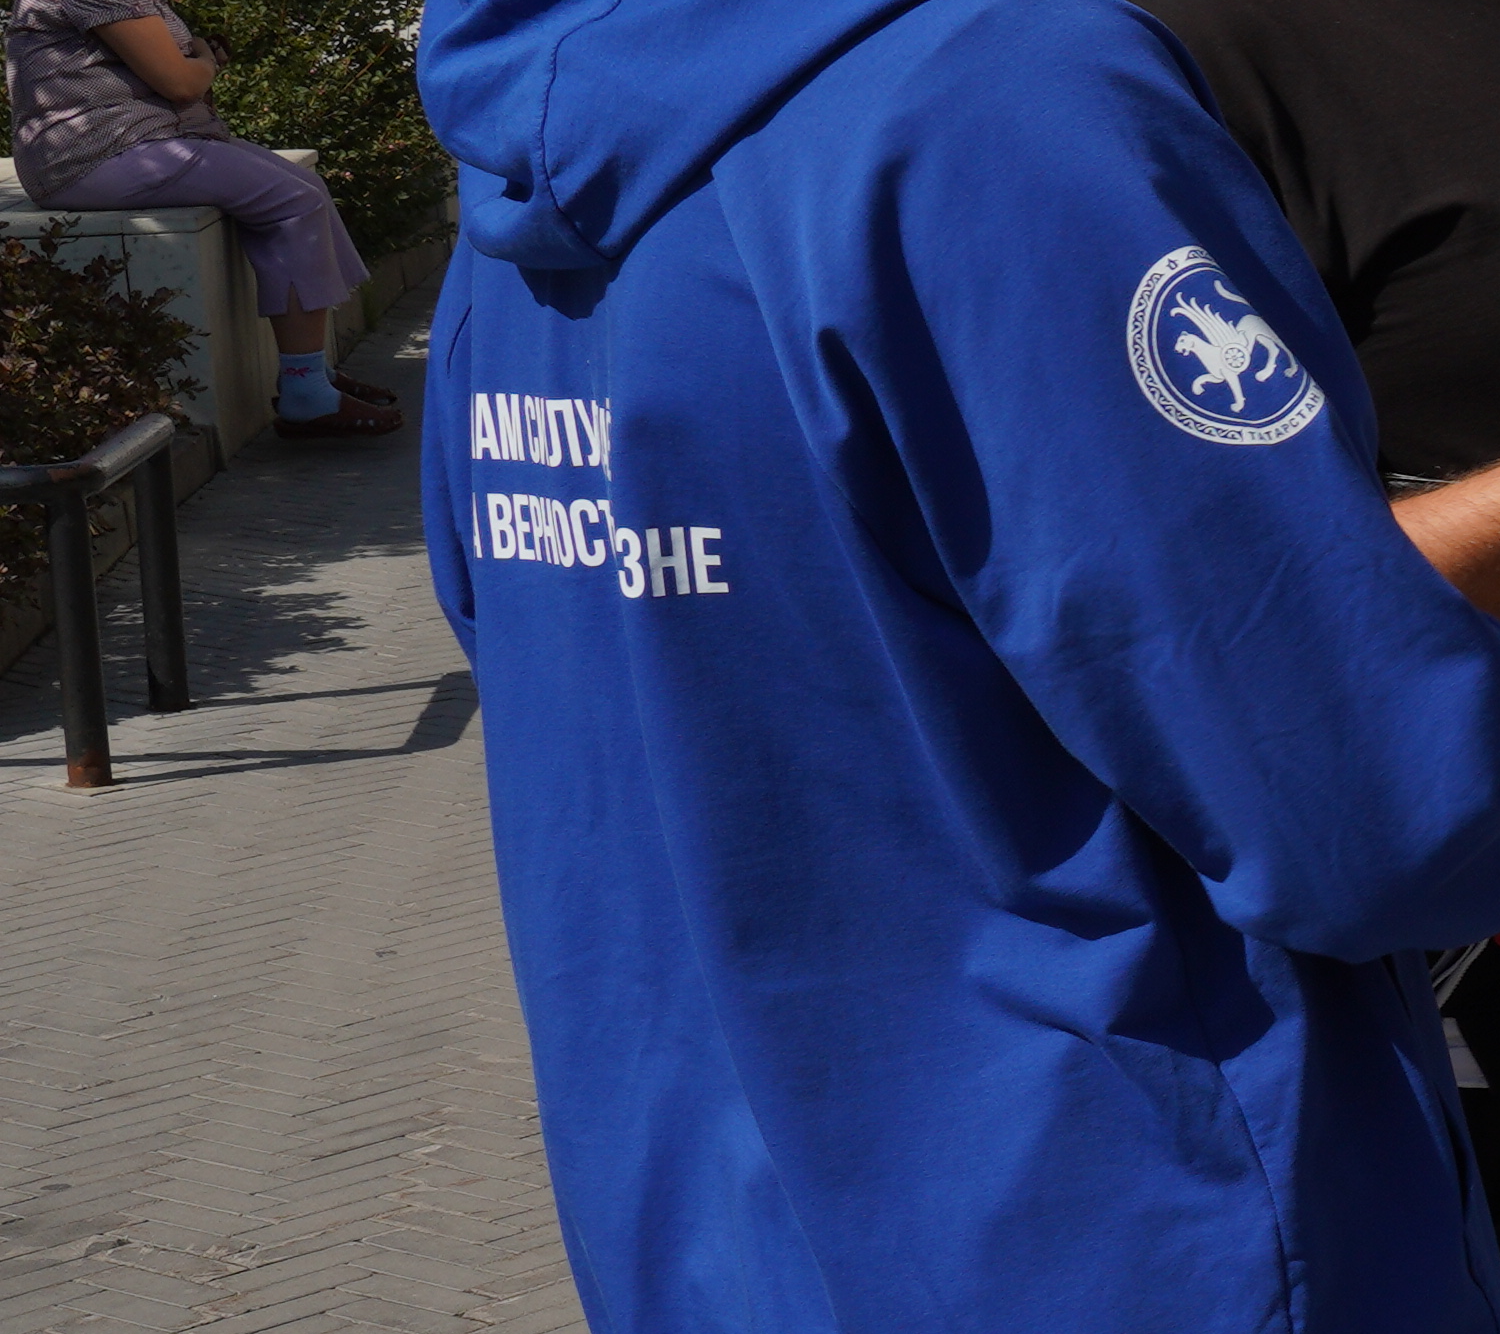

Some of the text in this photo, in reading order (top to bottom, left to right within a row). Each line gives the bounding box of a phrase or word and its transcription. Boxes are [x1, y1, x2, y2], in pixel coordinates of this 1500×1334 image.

[471, 392, 526, 462] АМ
[1248, 391, 1322, 442] ТАТАРСТАН
[487, 492, 616, 568] ВЕРНОСТ
[615, 526, 730, 599] ЗНЕ
